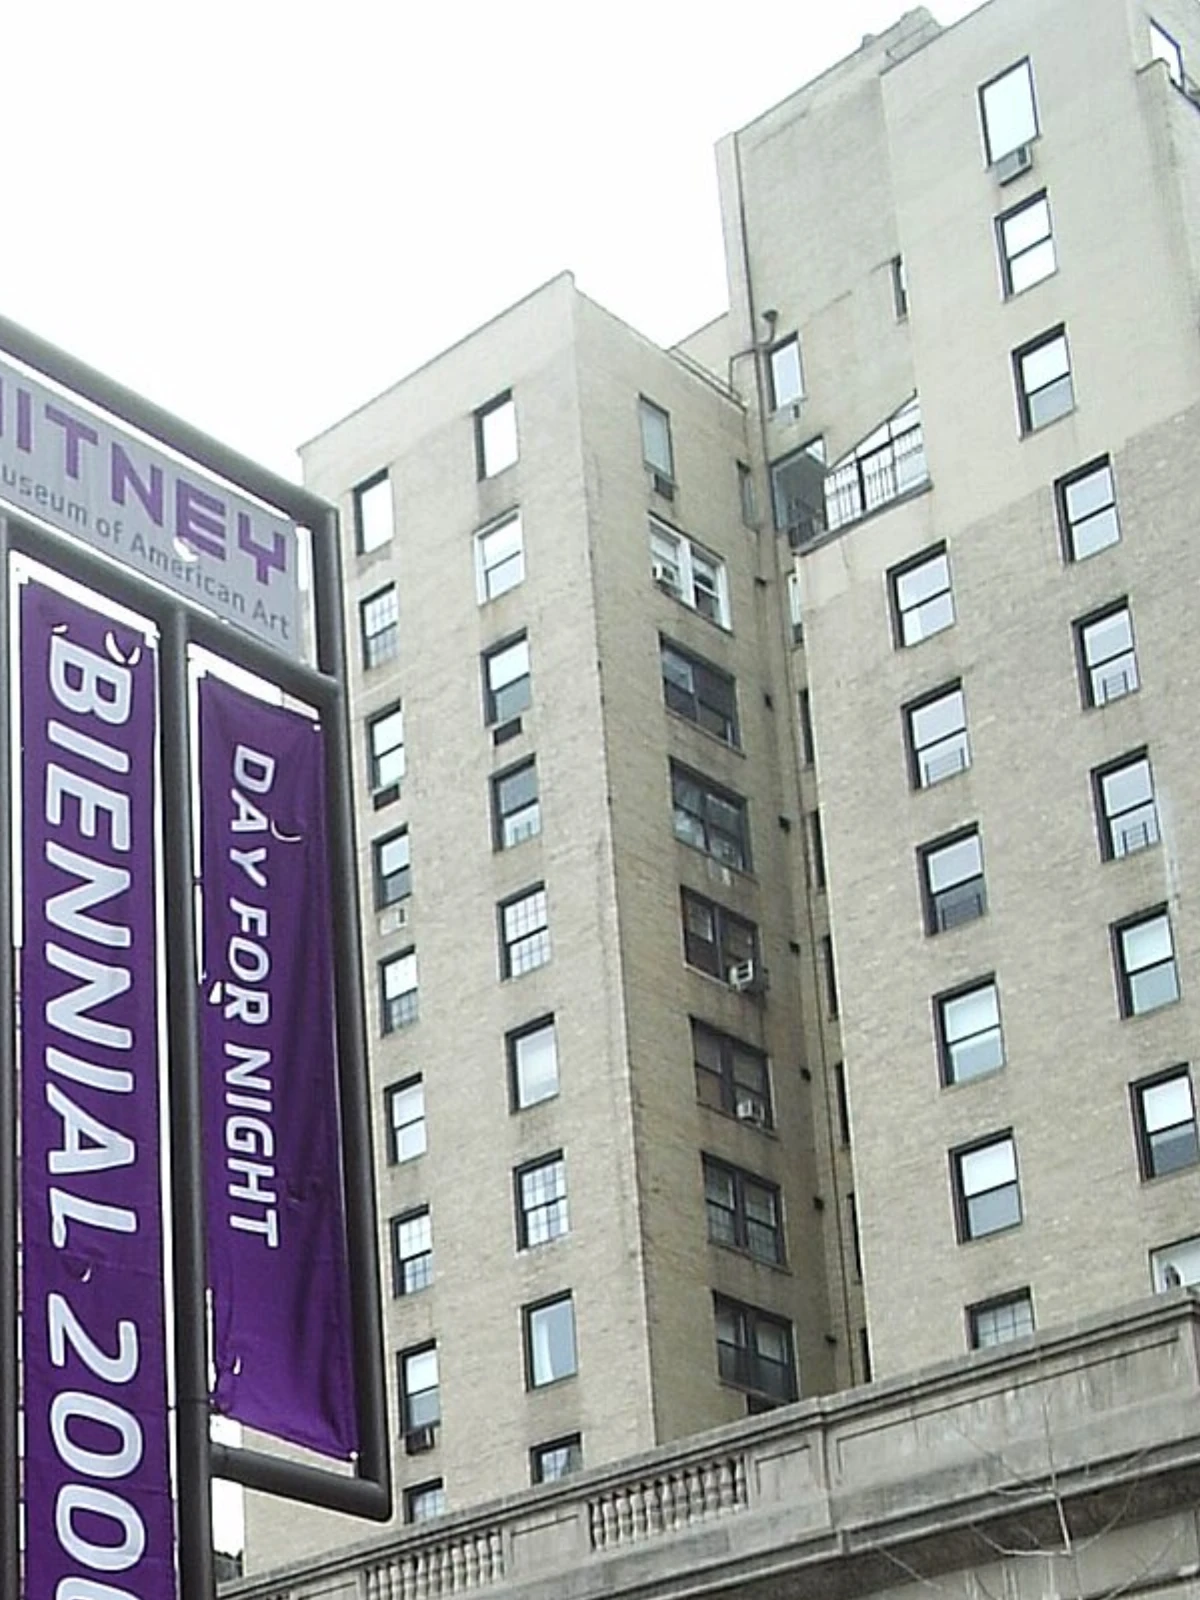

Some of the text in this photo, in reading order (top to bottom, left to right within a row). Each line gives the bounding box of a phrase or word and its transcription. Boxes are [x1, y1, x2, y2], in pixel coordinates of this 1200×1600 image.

[95, 518, 124, 545] of
[130, 532, 245, 614] American
[251, 599, 290, 641] Art
[43, 633, 138, 1250] BIENNIAL
[222, 743, 280, 1249] DAY FOR NIGHT
